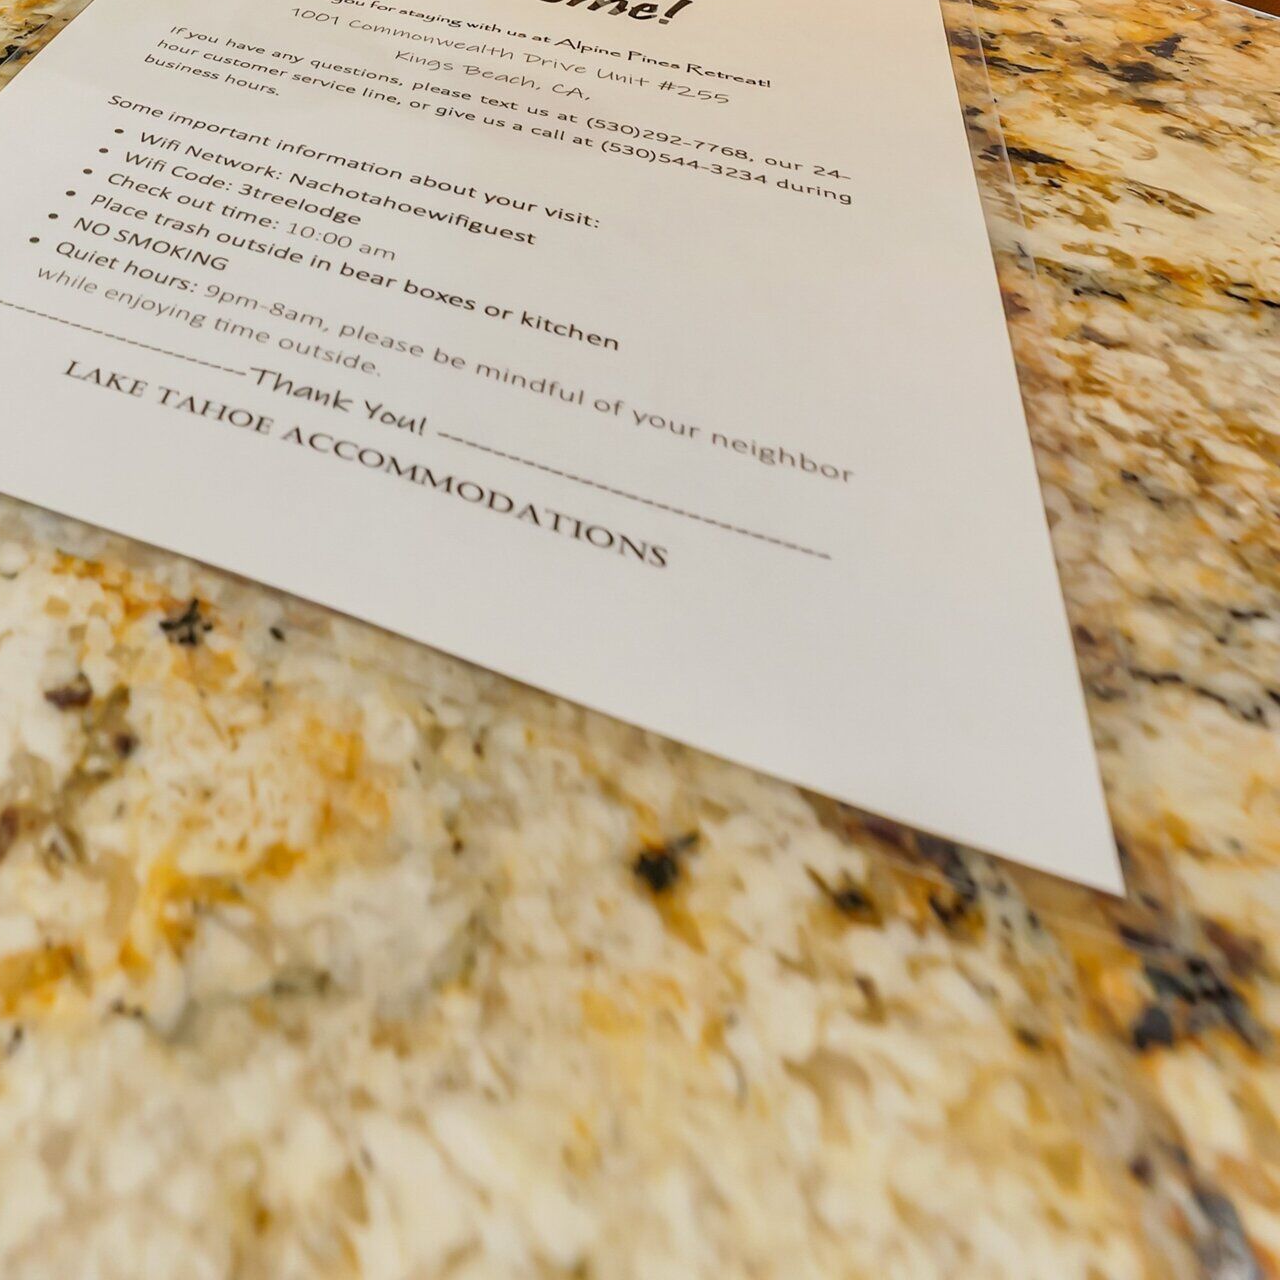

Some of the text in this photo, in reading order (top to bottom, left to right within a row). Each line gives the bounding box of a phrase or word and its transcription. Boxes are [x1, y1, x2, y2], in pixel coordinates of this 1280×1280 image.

[142, 52, 280, 97] business hours.
[290, 6, 730, 104] 1001 Commonwealth Drive Unit #255
[368, 0, 397, 12] for
[397, 8, 463, 28] staying
[465, 21, 502, 34] with
[505, 28, 528, 39] us
[530, 34, 552, 44] at
[552, 37, 622, 58] Alpine
[626, 49, 681, 70] Pines
[685, 61, 771, 89] Retreat!
[393, 49, 591, 101] Kings Beach, CA,
[155, 38, 852, 206] hour customer service line, or give us a call at (530)544-3234 during
[169, 25, 852, 180] If you have any questions, please text us at (530)292-7768, our 24-
[106, 93, 600, 229] Some important information about your visit:
[124, 149, 362, 226] Wifi Code: 3treelodge
[139, 130, 537, 246] Wifi Network: Nachotahoewifiguest
[72, 215, 230, 272] NO SMOKING
[106, 171, 396, 261] Check out time: 10:00 am
[36, 266, 381, 377] while enjoying time outside.
[89, 192, 619, 352] Place trash outside in bear boxes or kitchen
[54, 240, 854, 483] Quiet hours: 9pm-8am, please be mindful of your neighbor
[61, 358, 670, 570] LAKE TAHOE ACCOMMODATIONS
[363, 398, 428, 437] You!
